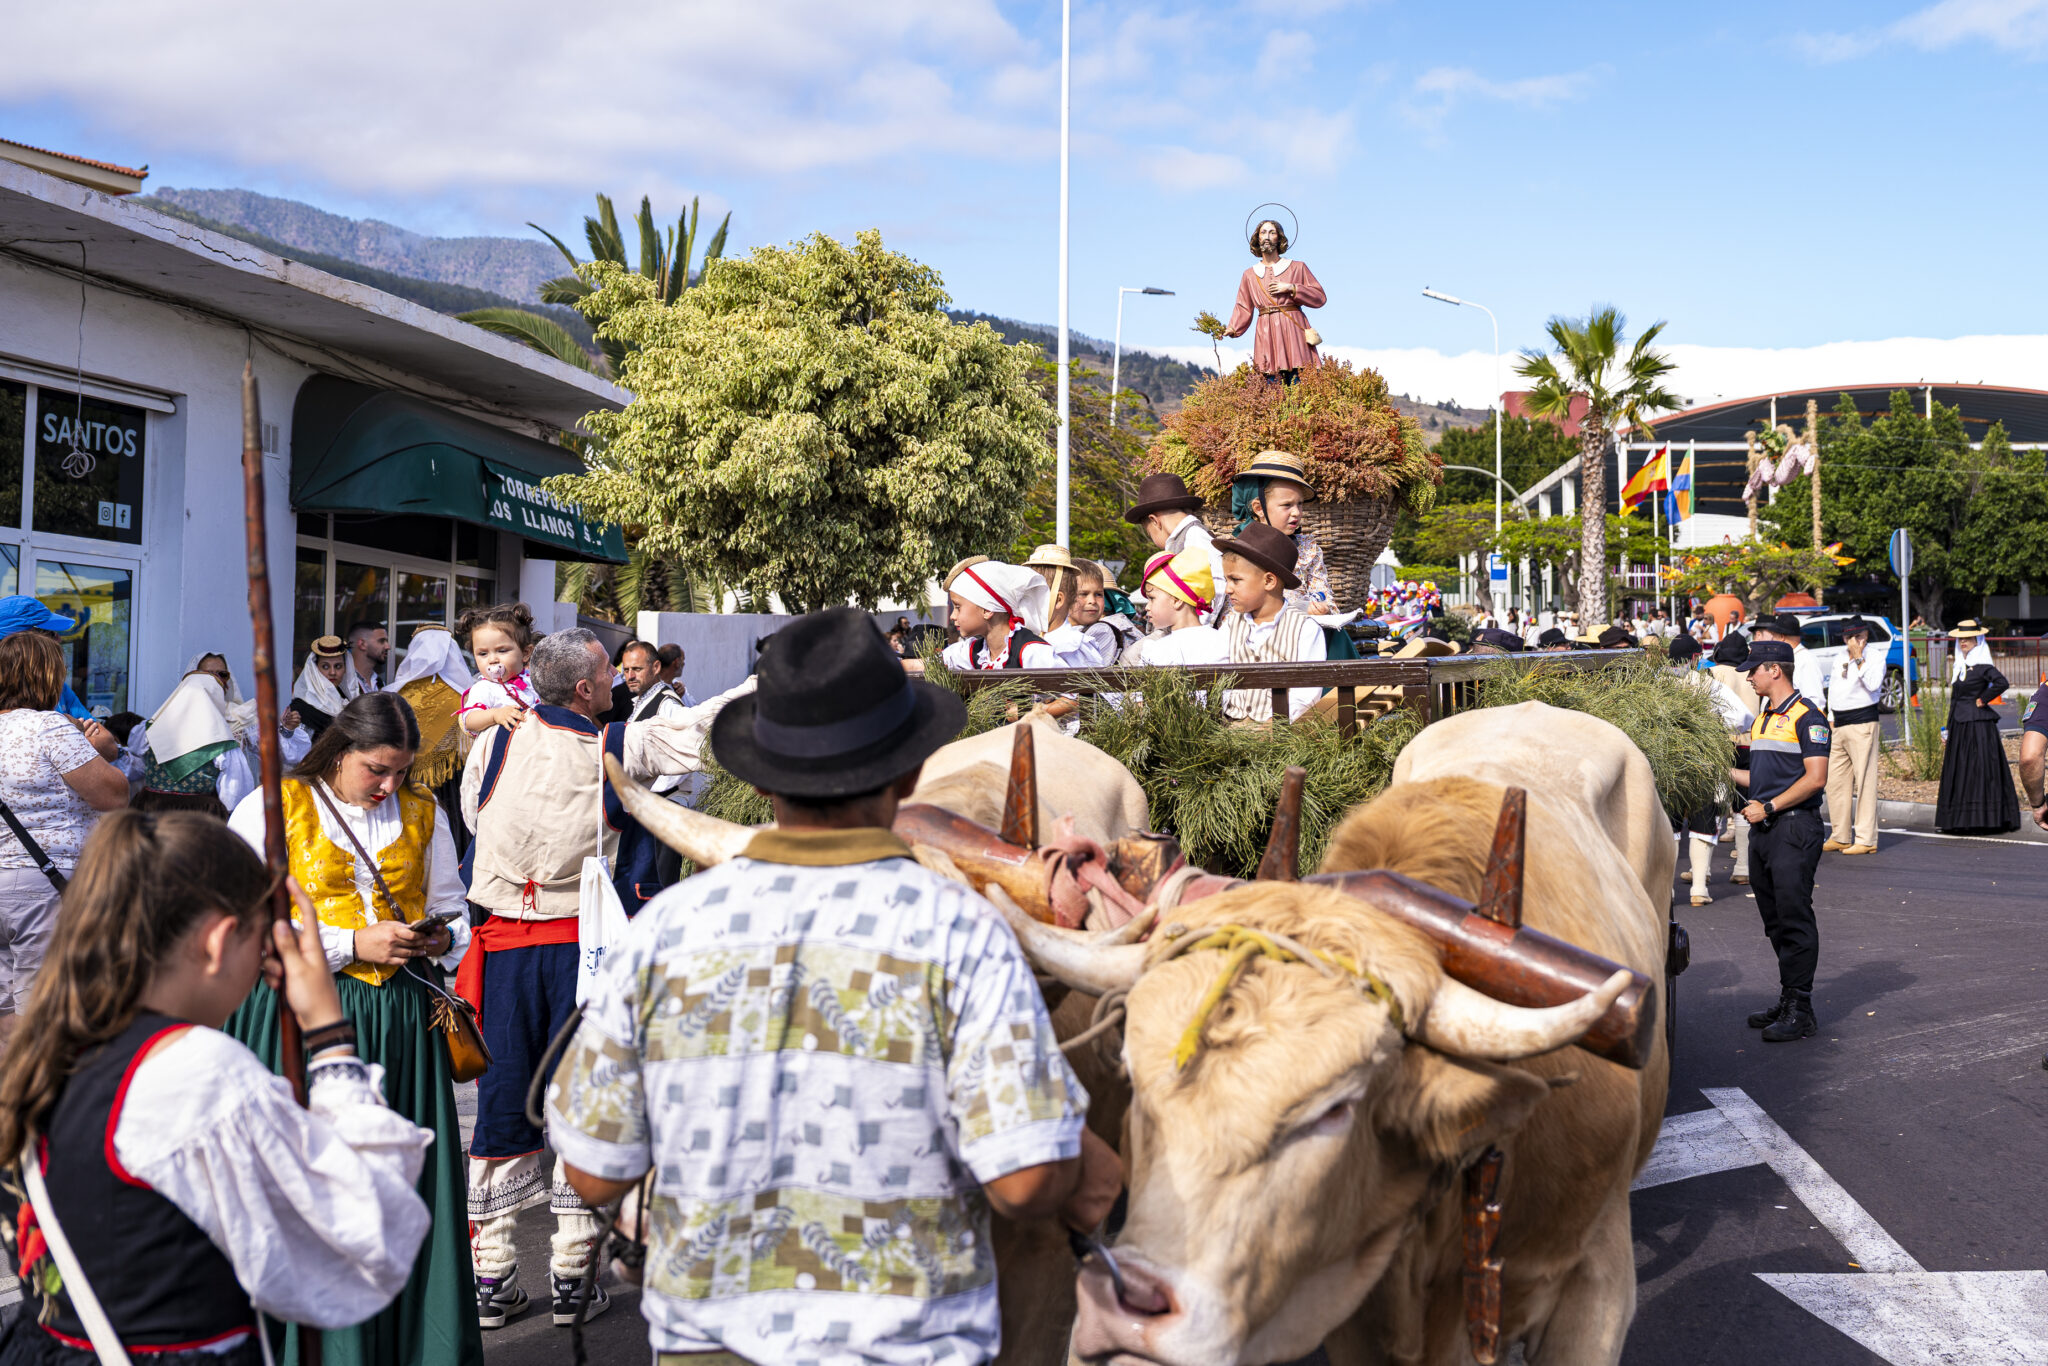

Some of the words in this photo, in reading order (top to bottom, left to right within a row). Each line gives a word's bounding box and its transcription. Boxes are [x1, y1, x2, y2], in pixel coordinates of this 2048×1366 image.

[43, 412, 137, 457] SANTOS
[489, 499, 512, 521] OS
[521, 507, 575, 540] LLANOS
[479, 1286, 494, 1294] NIKE
